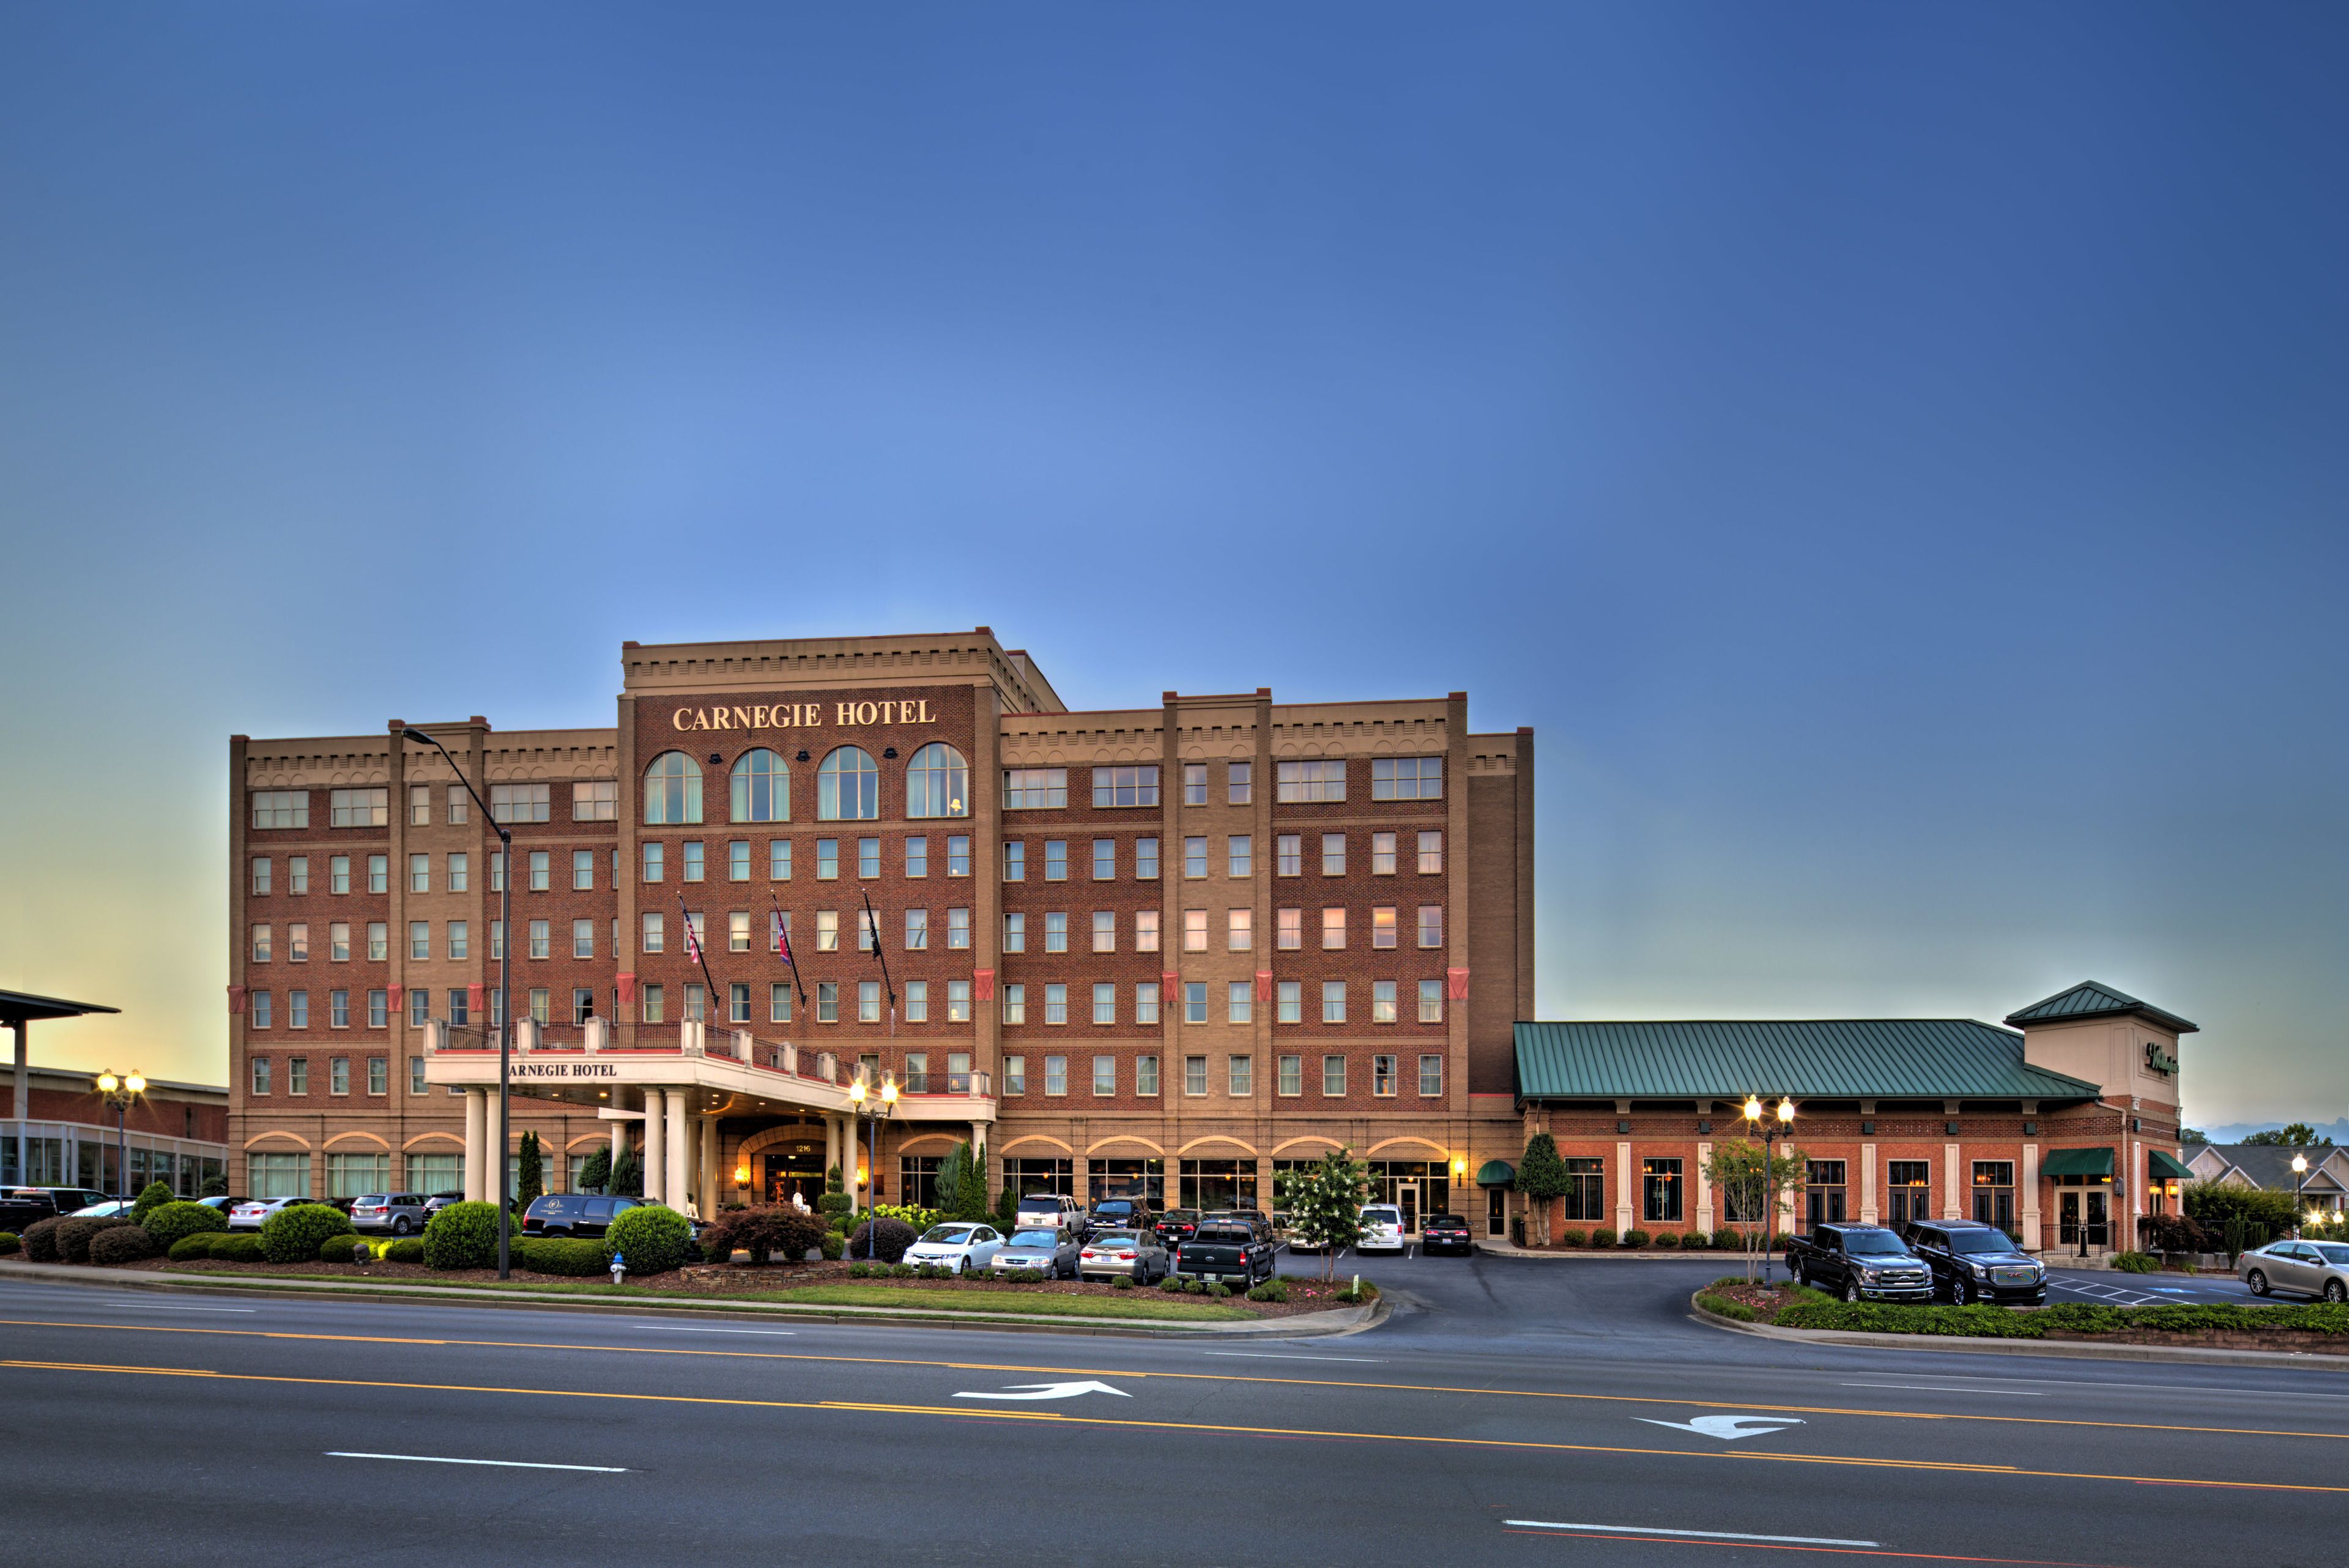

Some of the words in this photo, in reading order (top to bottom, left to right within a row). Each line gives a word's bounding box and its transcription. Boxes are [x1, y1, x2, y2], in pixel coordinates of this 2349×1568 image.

[672, 704, 821, 731] CARNEGIE
[836, 700, 936, 726] HOTEL
[509, 1065, 568, 1076] ARNEGIE
[573, 1065, 617, 1076] HOTEL
